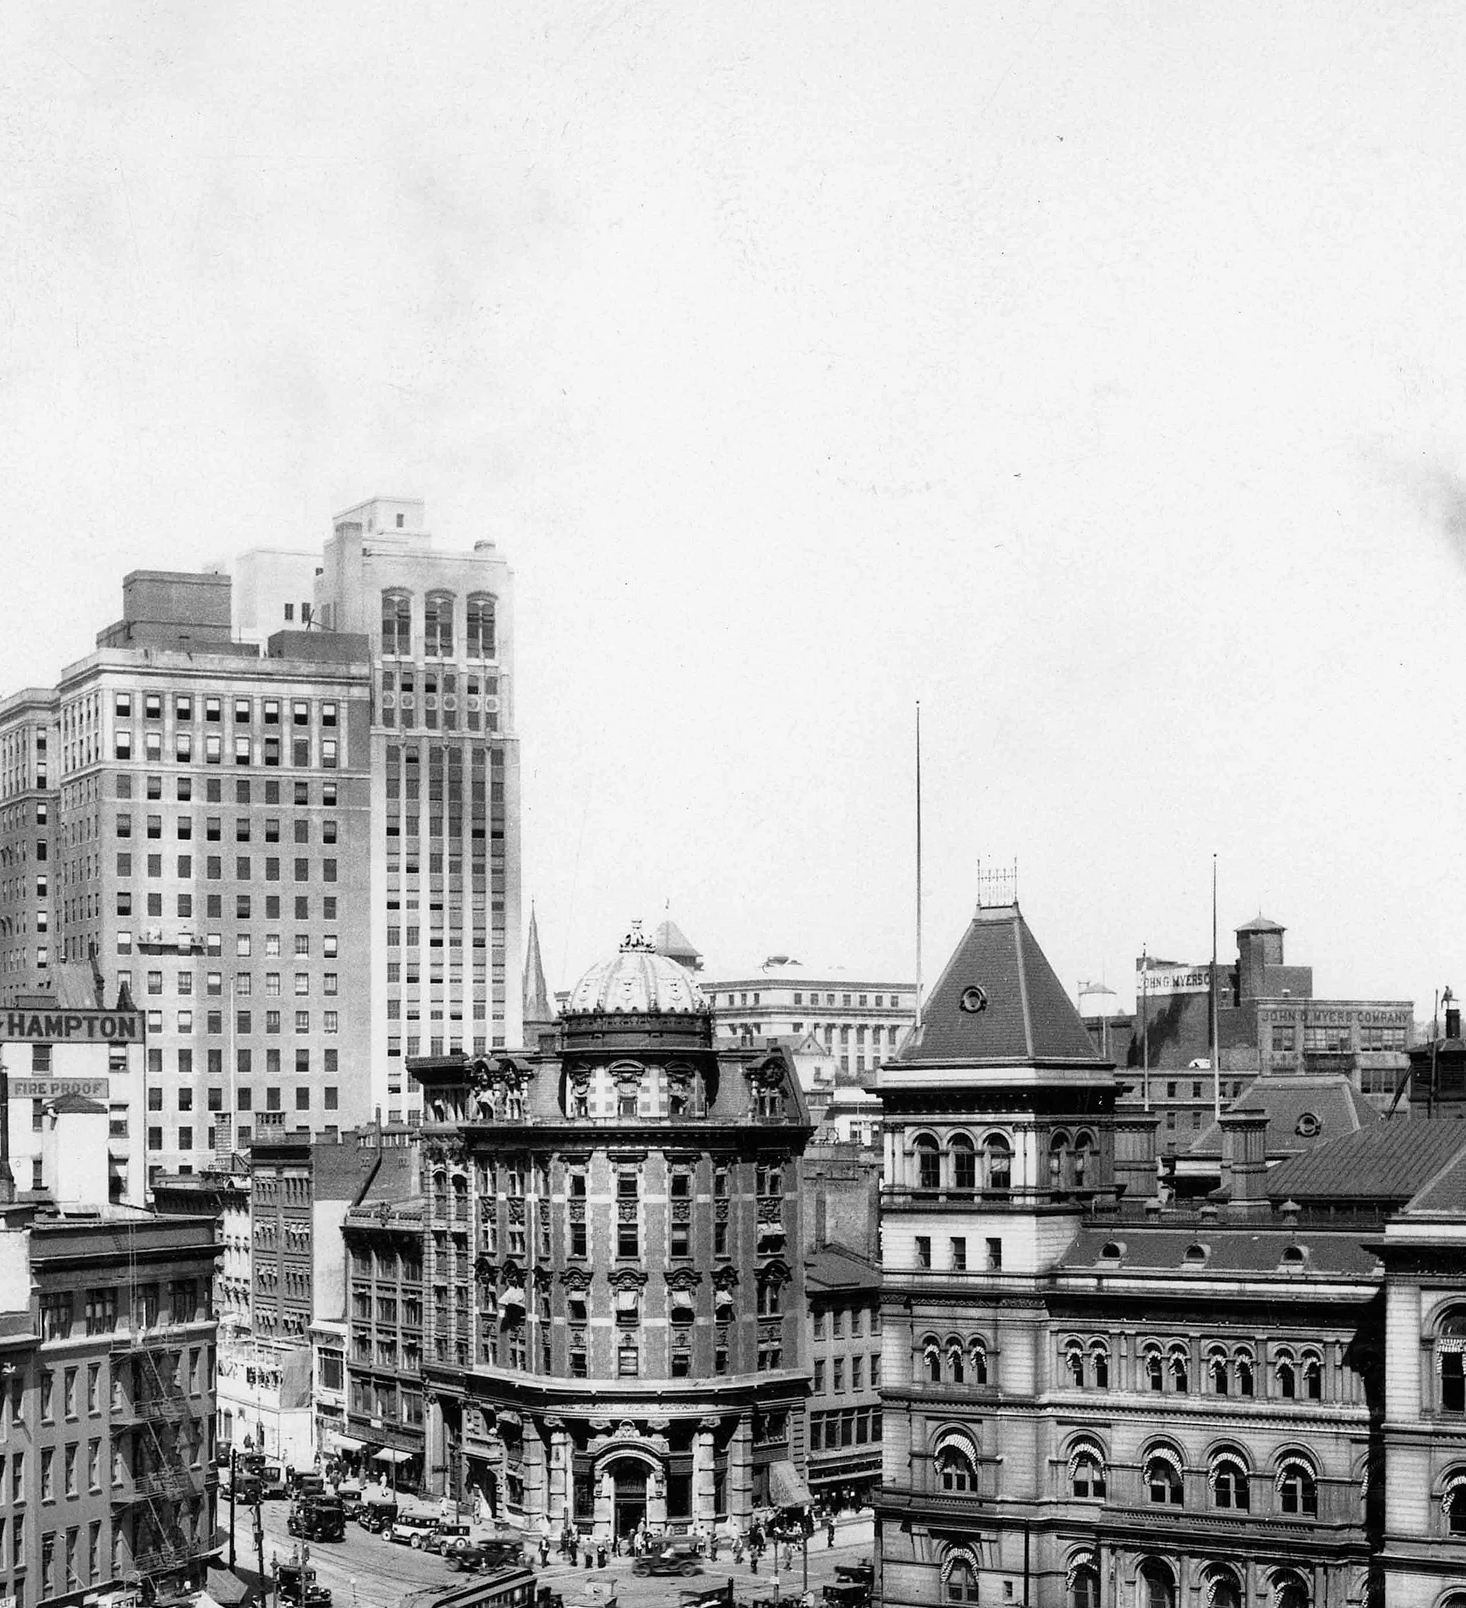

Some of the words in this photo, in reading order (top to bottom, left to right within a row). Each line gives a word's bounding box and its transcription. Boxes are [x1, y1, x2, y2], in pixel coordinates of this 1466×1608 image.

[1173, 973, 1202, 987] MYERS
[1261, 1010, 1296, 1022] JOHN
[1357, 1011, 1409, 1023] COMPANY
[8, 1013, 136, 1038] HAMPTON
[14, 1082, 47, 1095] FIRE
[50, 1082, 103, 1096] PROOF
